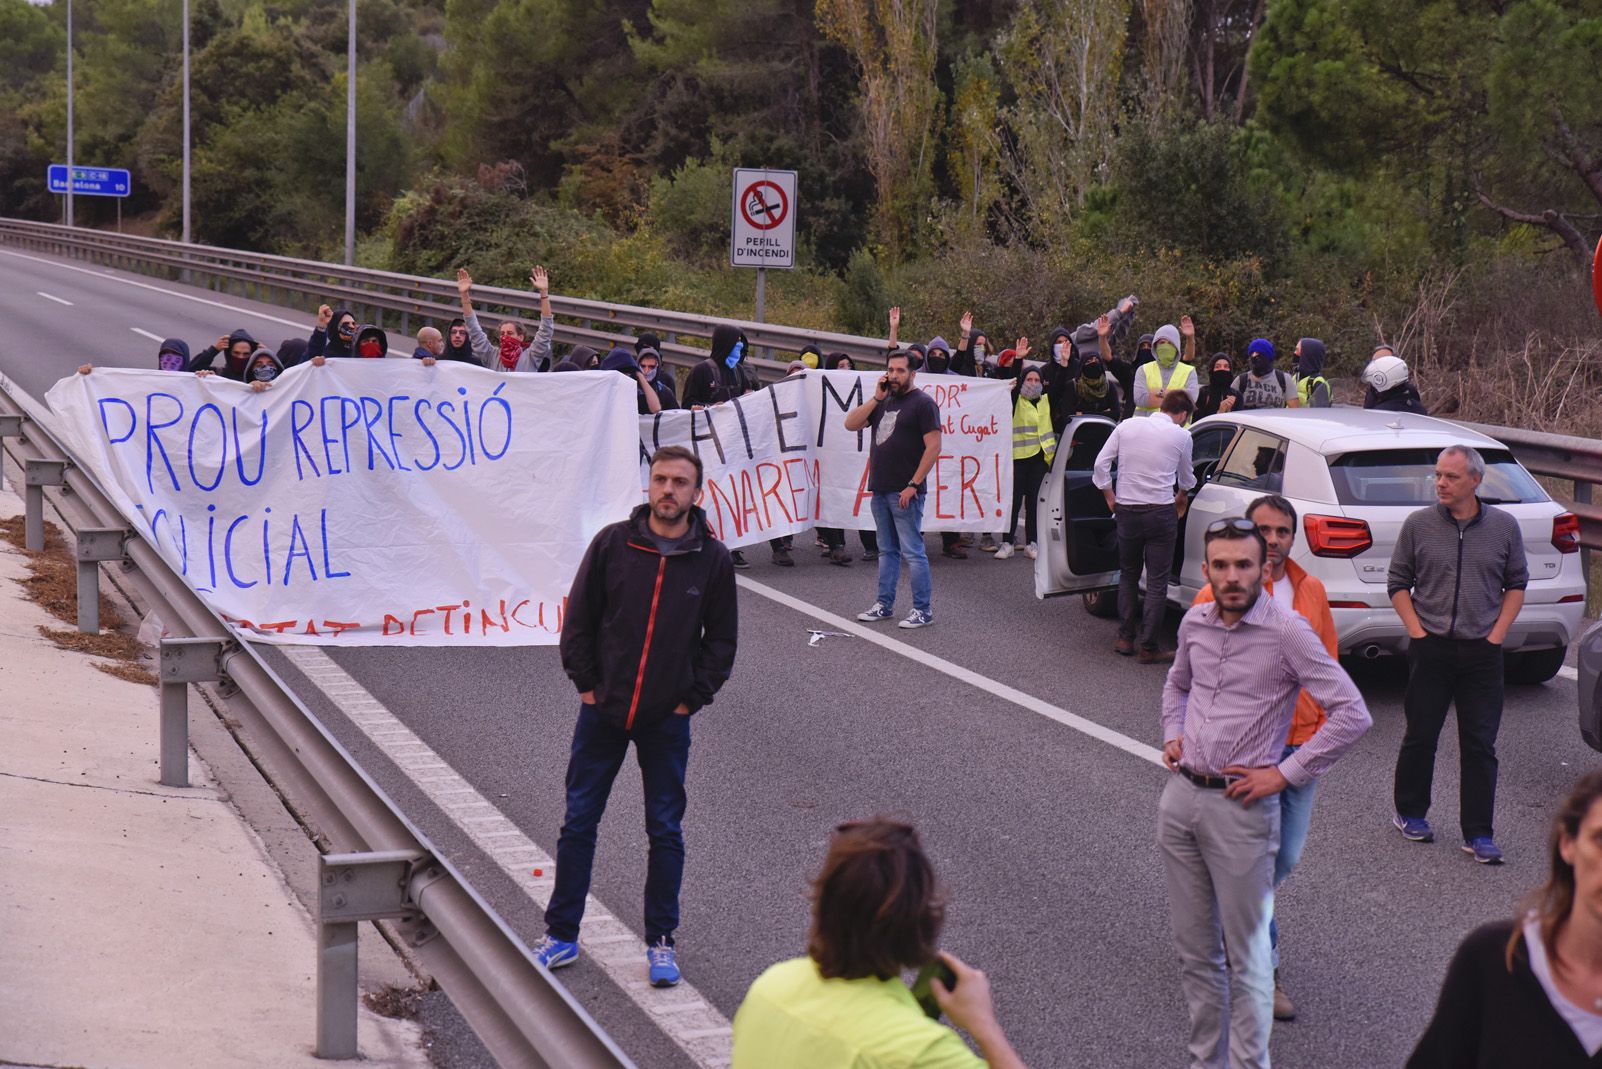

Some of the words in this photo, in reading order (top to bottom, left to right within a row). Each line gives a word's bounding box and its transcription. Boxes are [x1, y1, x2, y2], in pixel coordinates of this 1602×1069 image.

[115, 183, 126, 191] 10
[737, 248, 790, 258] D'INCENDI
[98, 392, 268, 495] PROU
[940, 414, 955, 434] nt
[960, 414, 998, 442] Cugat
[694, 458, 820, 541] NAREM
[935, 453, 1003, 520] ER!
[134, 504, 352, 593] LICIAL
